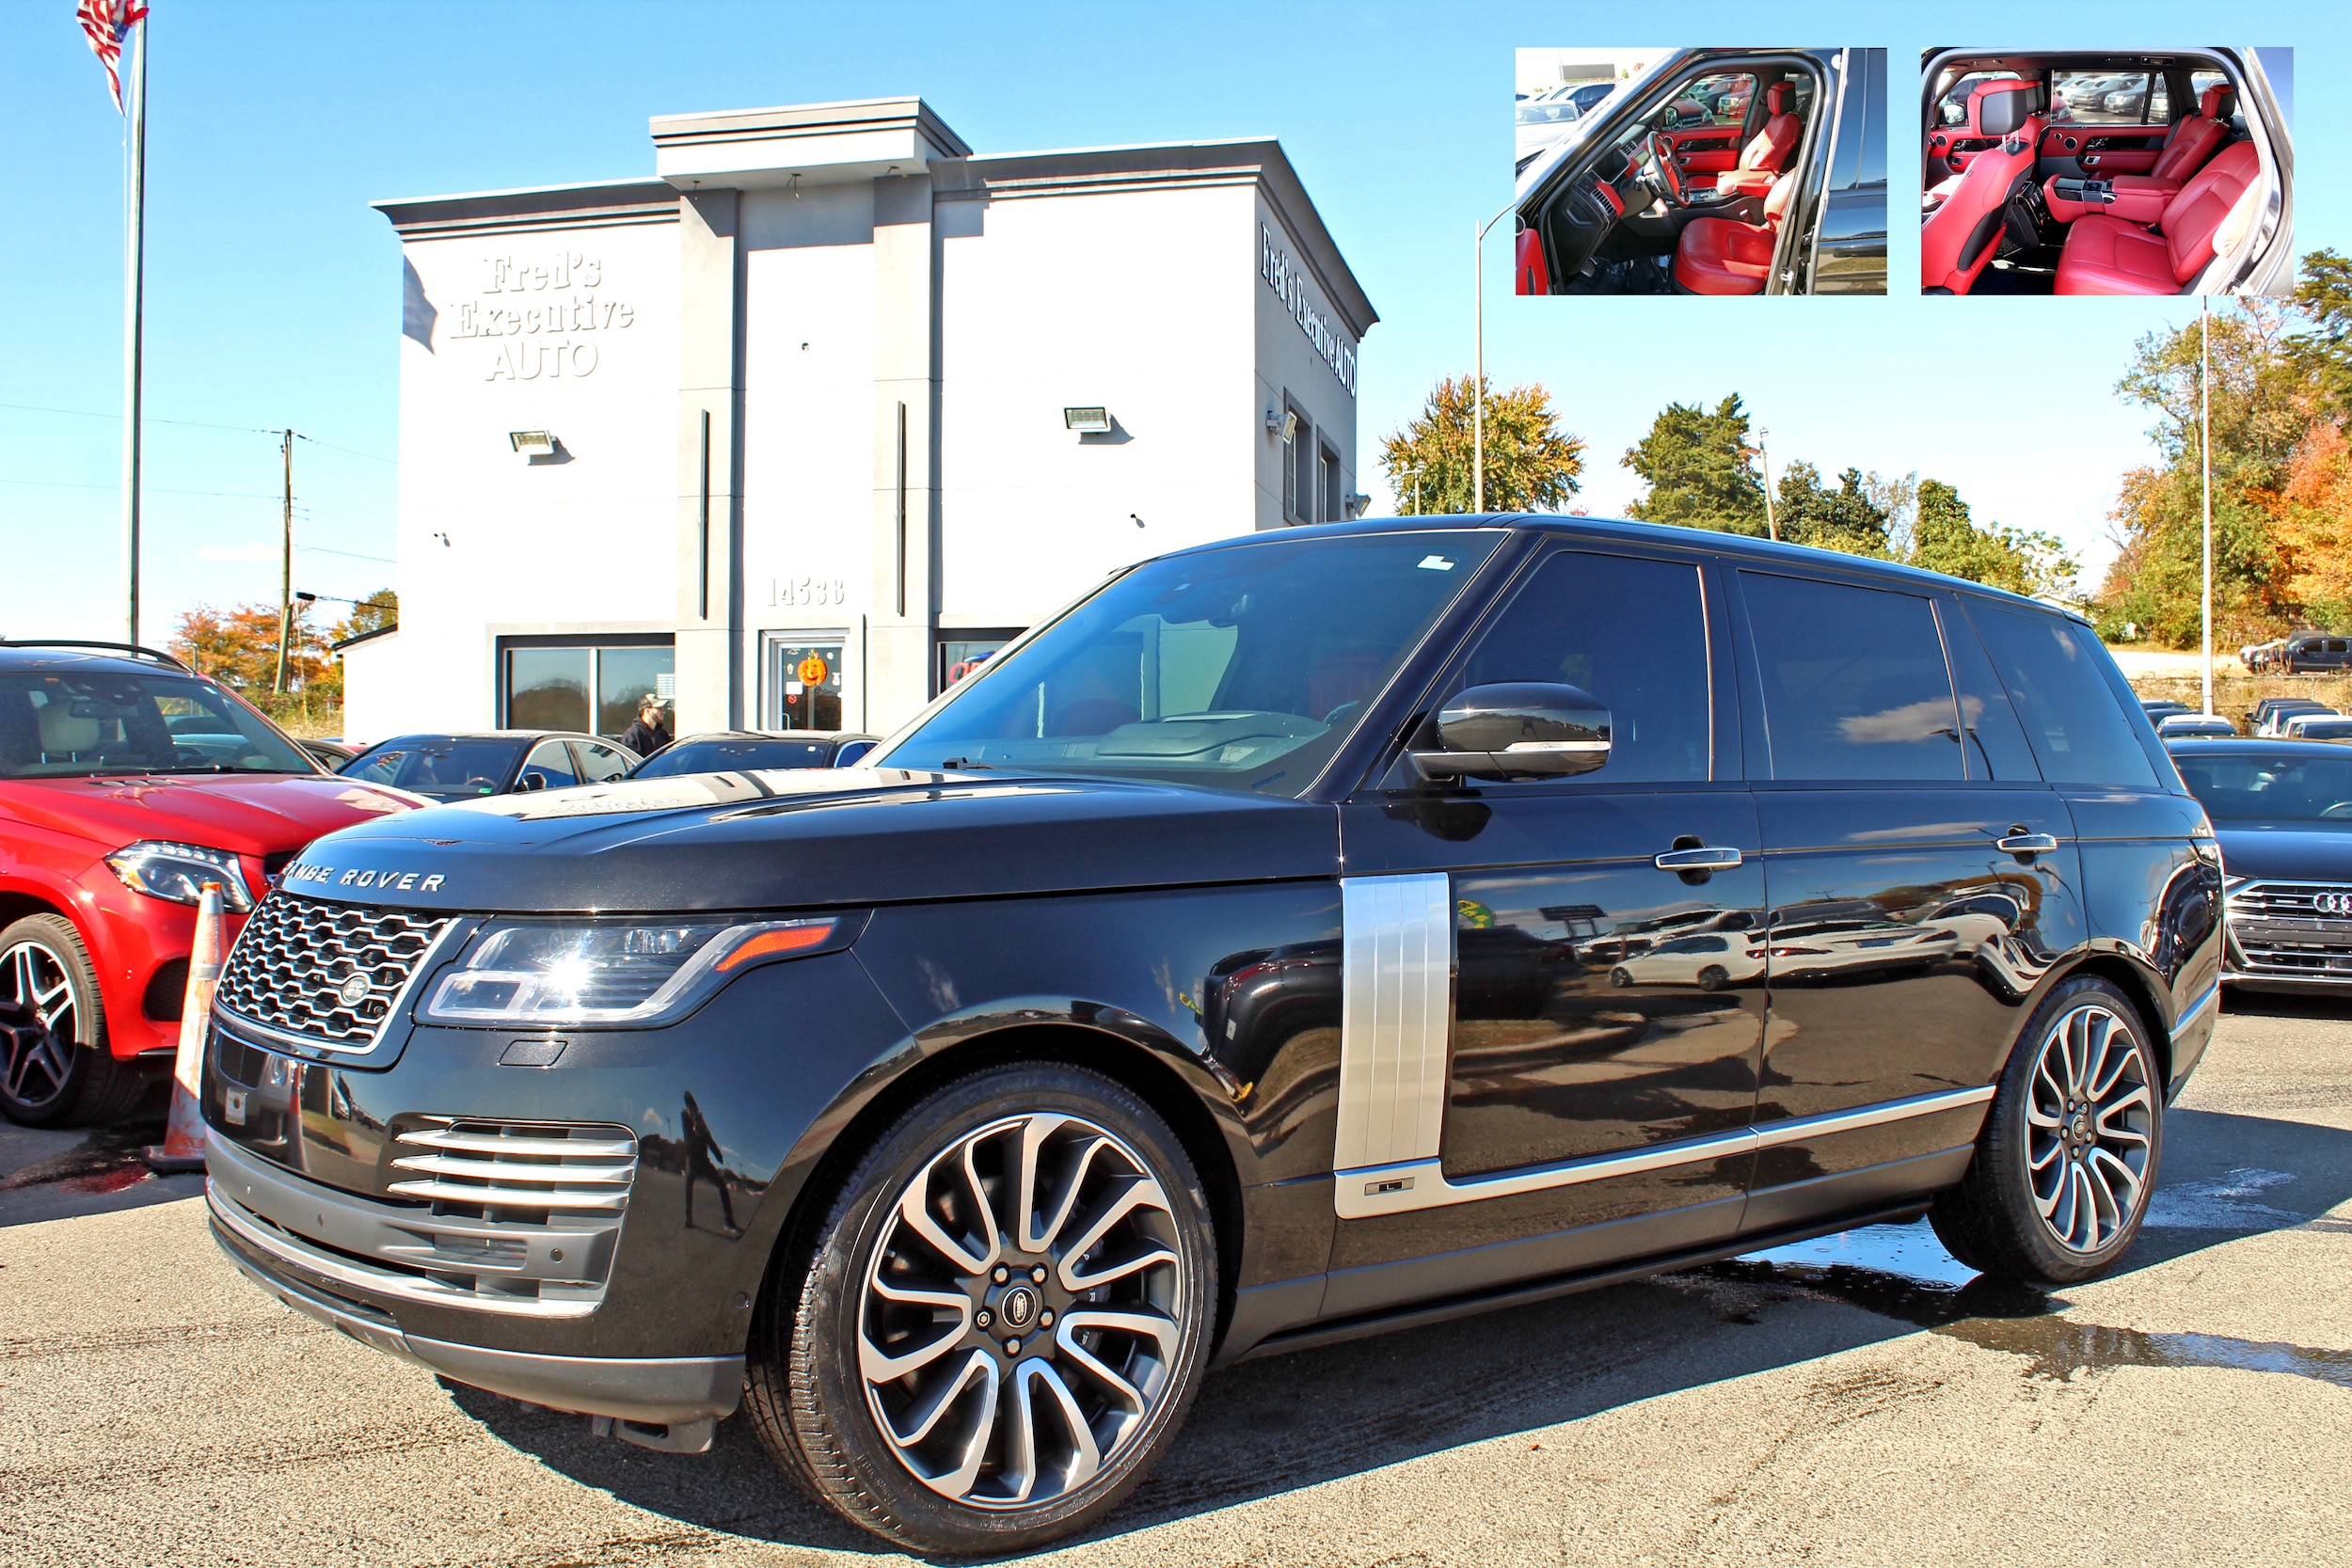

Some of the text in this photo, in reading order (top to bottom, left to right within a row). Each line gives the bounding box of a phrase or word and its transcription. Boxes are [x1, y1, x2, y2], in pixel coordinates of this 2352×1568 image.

[483, 251, 601, 293] Fred's
[450, 295, 634, 339] Executive
[1261, 223, 1357, 398] Fred's Executive AUTO
[485, 340, 598, 381] AUTO
[340, 868, 447, 893] ROVER
